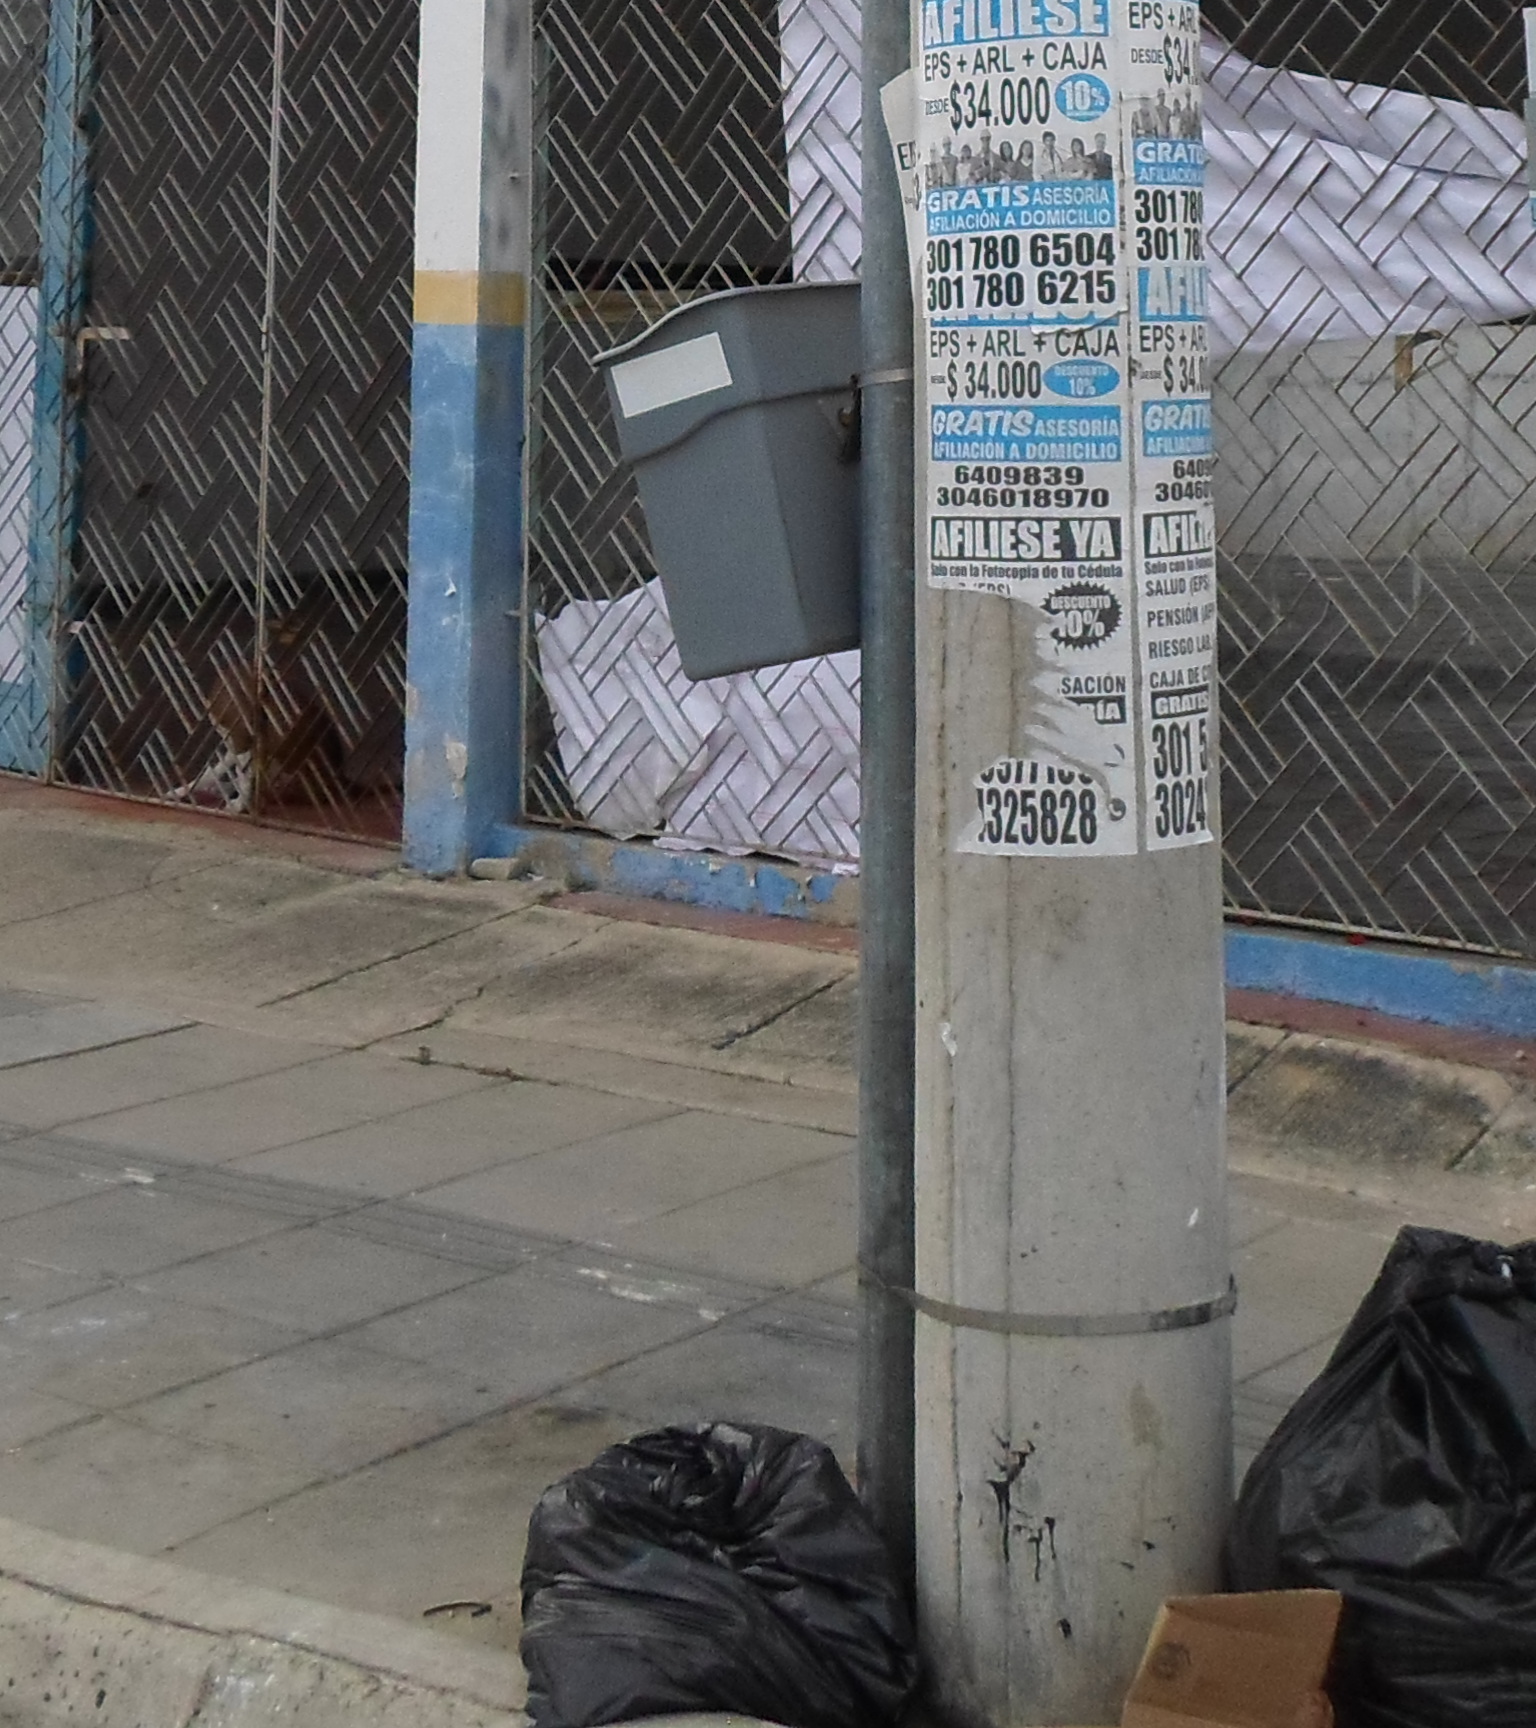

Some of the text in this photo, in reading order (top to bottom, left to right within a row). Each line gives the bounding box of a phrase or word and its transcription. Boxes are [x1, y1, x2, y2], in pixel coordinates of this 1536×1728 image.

[1129, 0, 1164, 30] EPS
[925, 51, 951, 82] EPS
[972, 46, 1015, 75] ARL
[1043, 41, 1108, 70] CAJA
[1130, 47, 1164, 64] DESDE
[950, 79, 1051, 135] $34.000
[927, 183, 1110, 213] GRATIS ASESORÍA
[1134, 189, 1177, 224] 301
[929, 209, 1111, 233] AFILIACIÓN A DOMICILIO
[927, 232, 1116, 274] 301 780 6504
[1136, 226, 1179, 262] 301
[927, 270, 1116, 312] 301 780 6215
[930, 330, 961, 358] EPS
[982, 330, 1026, 357] ARL
[1055, 329, 1121, 357] CAJA
[1140, 324, 1176, 352] EPS
[965, 360, 1042, 399] 34.000
[932, 410, 1120, 437] GRATIS ASESORÍA
[1009, 442, 1021, 460] A
[1026, 442, 1118, 460] DOMICILIO
[954, 465, 1085, 486] 6409839
[937, 487, 1110, 508] 3046018970
[933, 519, 1116, 560] AFILIESE YA
[969, 564, 981, 577] la
[1042, 564, 1060, 578] de
[1061, 566, 1076, 578] tu
[1077, 563, 1124, 579] Cédula
[1145, 577, 1187, 597] SALUD
[1051, 595, 1111, 609] DESCUENTO
[1147, 602, 1199, 628] PENSIÓN
[1148, 636, 1194, 660] RIESGO
[1150, 669, 1185, 689] CAJA
[1187, 666, 1199, 685] DE
[1152, 721, 1192, 779] 301
